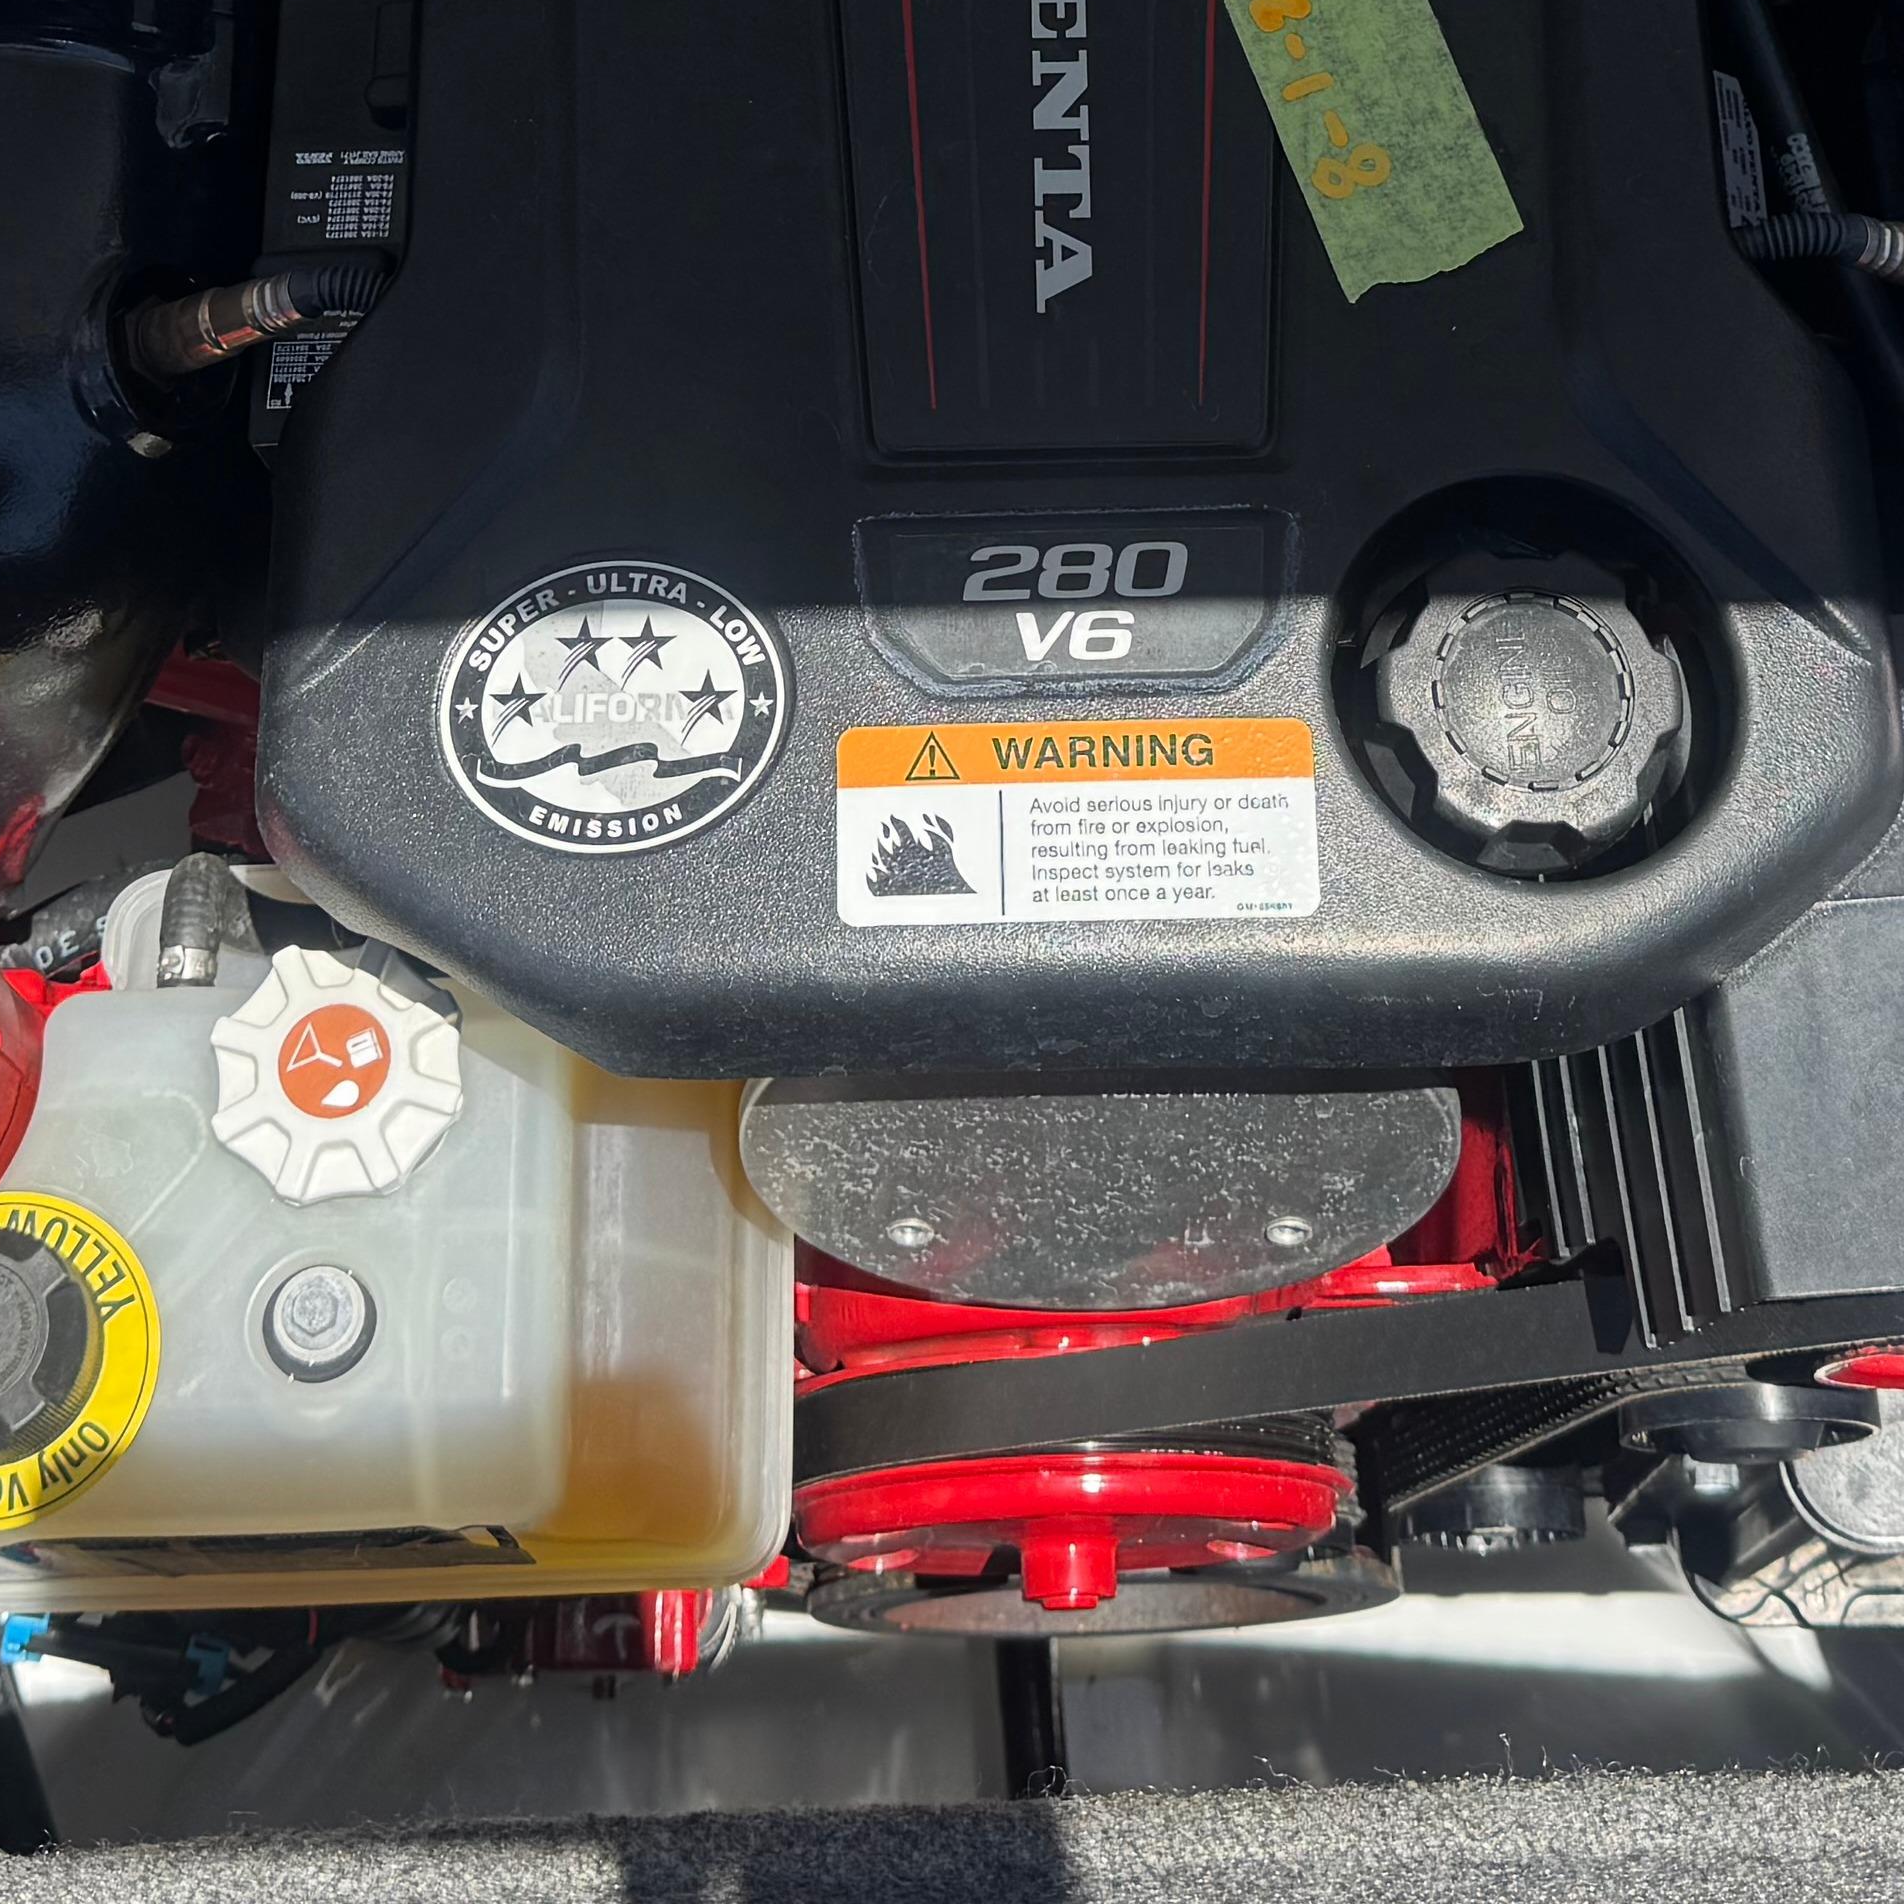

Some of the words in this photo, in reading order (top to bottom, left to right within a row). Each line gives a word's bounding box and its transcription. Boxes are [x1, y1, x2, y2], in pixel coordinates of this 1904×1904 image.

[962, 541, 1189, 602] 280
[468, 587, 560, 673] SUPER
[585, 571, 689, 605] ULTRA
[708, 604, 767, 667] LOW
[1015, 609, 1135, 662] V6
[991, 733, 1214, 770] WARNING
[527, 803, 684, 839] EMISSION
[1030, 796, 1080, 814] Avoid
[1087, 796, 1153, 812] serious
[1158, 794, 1208, 815] injury
[1213, 797, 1232, 810] or
[1238, 793, 1289, 810] death
[1030, 819, 1071, 836] from
[1078, 818, 1105, 834] fire
[1112, 821, 1130, 834] or
[1136, 817, 1229, 837] explosion,
[1031, 841, 1108, 860] resulting
[1114, 840, 1156, 856] from
[1162, 839, 1226, 857] leaking
[1032, 863, 1099, 883] Inspect
[1105, 864, 1171, 882] system
[1177, 862, 1202, 878] for
[1207, 860, 1255, 877] leaks
[1032, 889, 1049, 903] at
[1055, 886, 1098, 903] least
[1105, 887, 1150, 901] once
[1156, 887, 1167, 901] a
[1173, 886, 1216, 904] year.
[6, 1208, 137, 1326] YELLOW
[37, 1420, 111, 1490] Only
